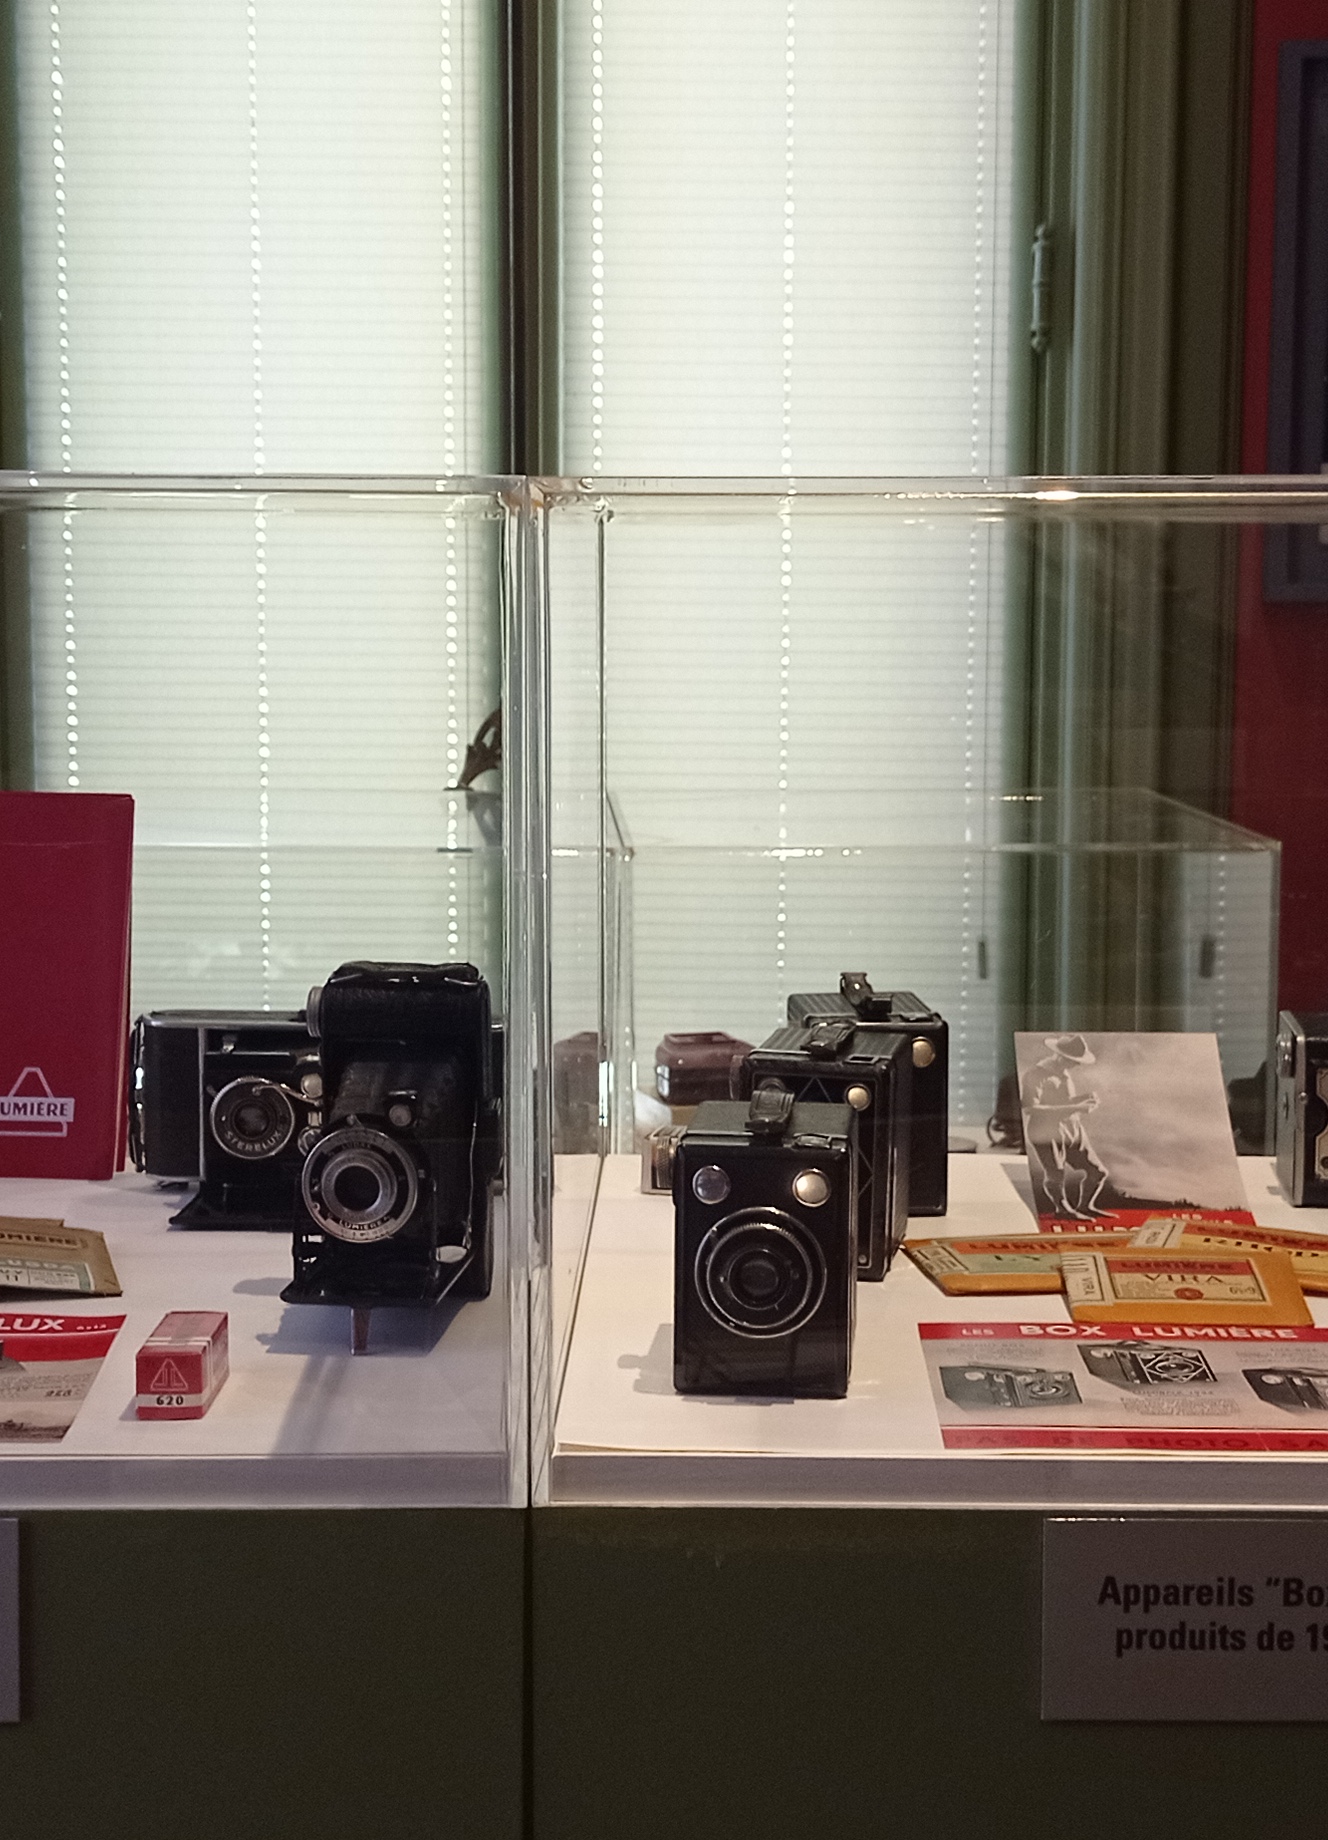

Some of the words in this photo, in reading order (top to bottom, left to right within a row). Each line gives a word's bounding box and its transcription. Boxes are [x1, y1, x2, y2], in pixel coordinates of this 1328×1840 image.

[224, 1130, 283, 1151] STERELUX
[1144, 1274, 1224, 1284] VIRA
[962, 1328, 995, 1336] LES
[1019, 1325, 1107, 1337] BOX
[1131, 1326, 1299, 1339] LUMIÈRE
[156, 1395, 184, 1406] 620
[1125, 1437, 1250, 1447] PHOTO
[1098, 1576, 1255, 1613] Appareils
[1116, 1622, 1246, 1657] produits
[1257, 1623, 1295, 1652] de
